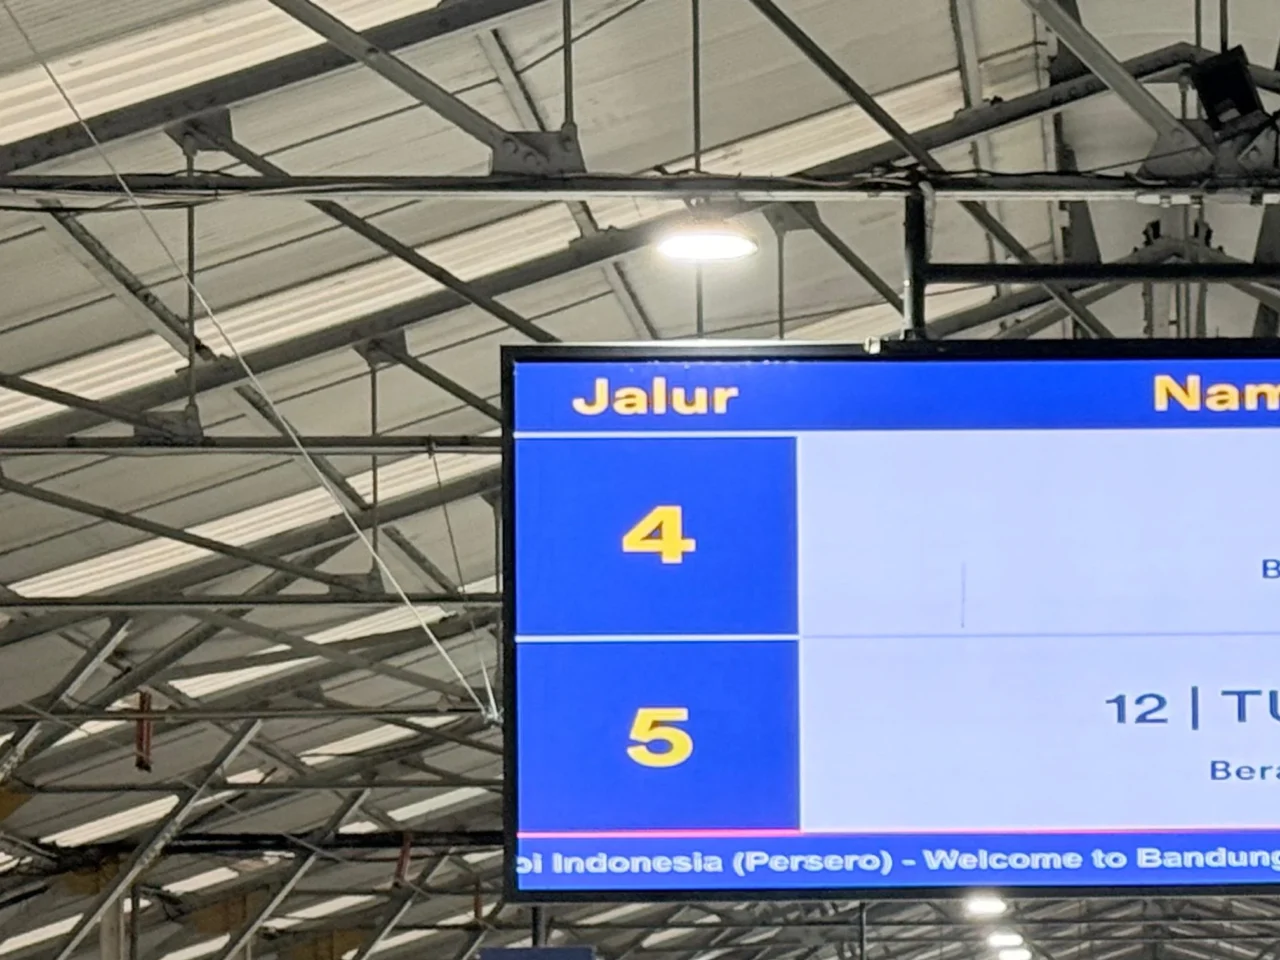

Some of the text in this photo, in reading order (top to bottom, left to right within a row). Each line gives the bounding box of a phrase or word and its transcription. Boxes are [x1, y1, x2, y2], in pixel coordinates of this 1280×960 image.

[573, 378, 739, 416] Jalur
[622, 505, 696, 565] 4
[1105, 692, 1170, 725] 12
[626, 706, 694, 767] 5
[552, 851, 724, 874] Indonesia
[732, 850, 893, 877] (Persero)
[922, 848, 1083, 871] Welcome
[1091, 849, 1127, 870] to
